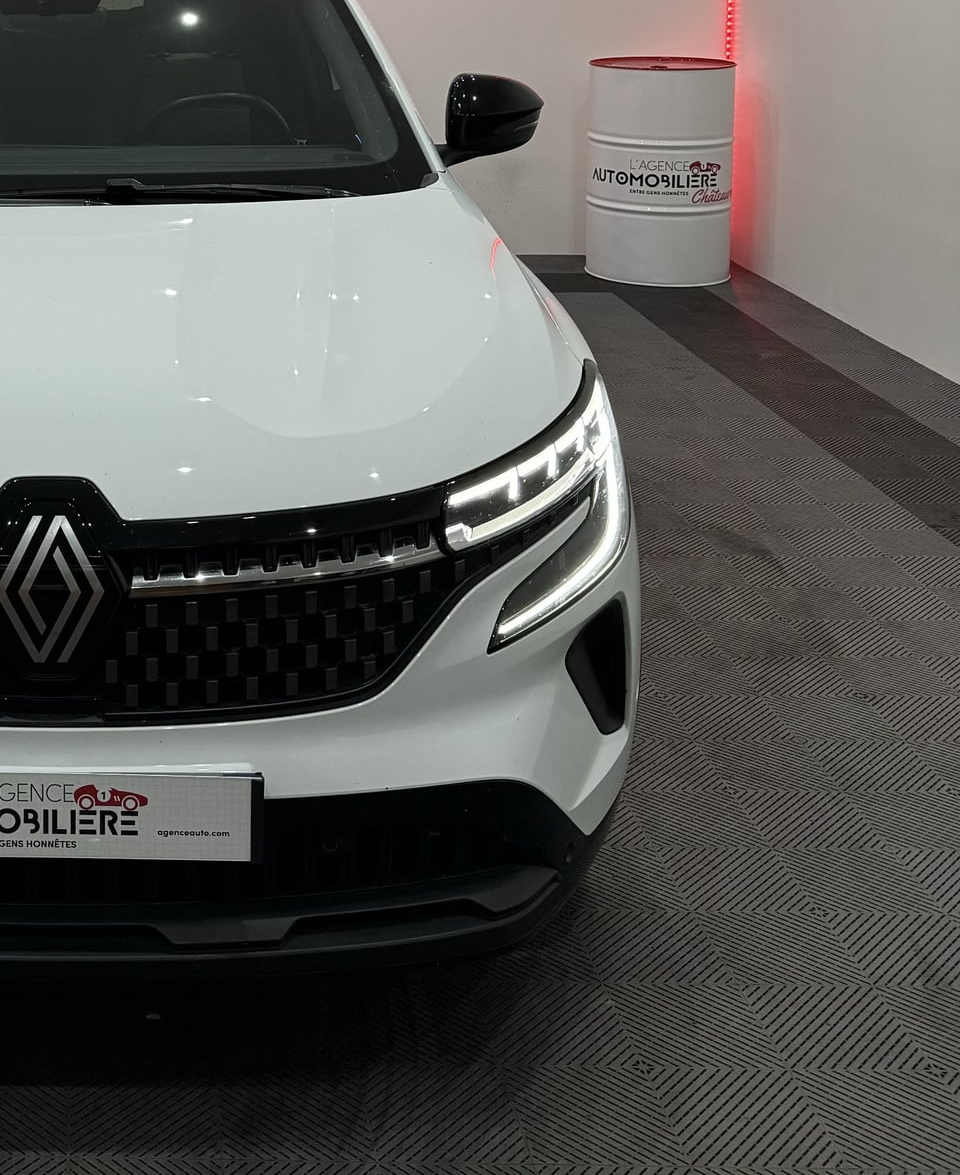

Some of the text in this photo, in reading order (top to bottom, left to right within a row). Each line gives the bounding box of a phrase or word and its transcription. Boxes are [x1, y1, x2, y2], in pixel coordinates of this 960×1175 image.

[629, 159, 690, 172] L'AGENCE
[157, 829, 230, 837] agenceauto.com
[26, 838, 78, 849] HONNÊTES
